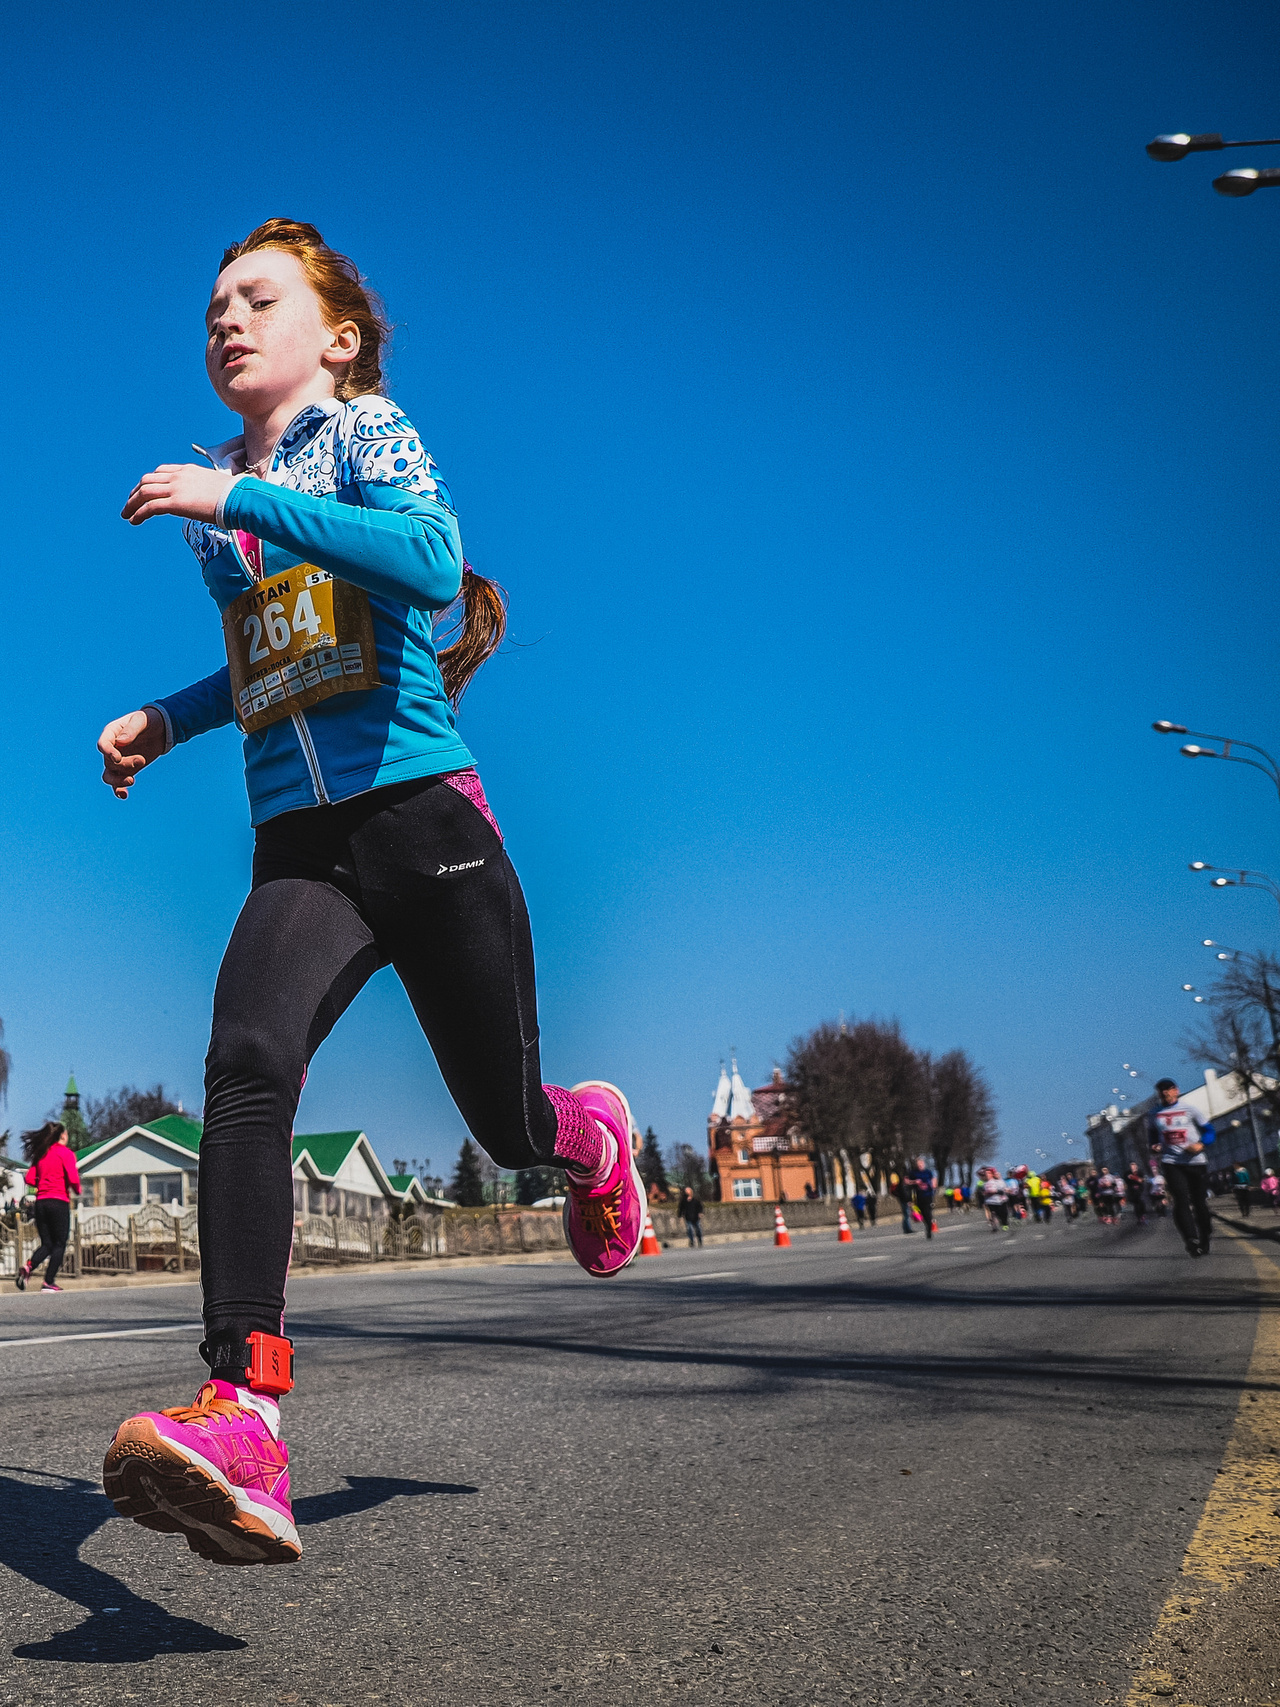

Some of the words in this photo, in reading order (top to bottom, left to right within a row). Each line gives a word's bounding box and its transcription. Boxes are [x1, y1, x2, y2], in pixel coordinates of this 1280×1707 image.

[311, 573, 320, 584] 5
[246, 580, 291, 611] TITAN
[243, 588, 322, 665] 264
[449, 858, 485, 873] DEMIX
